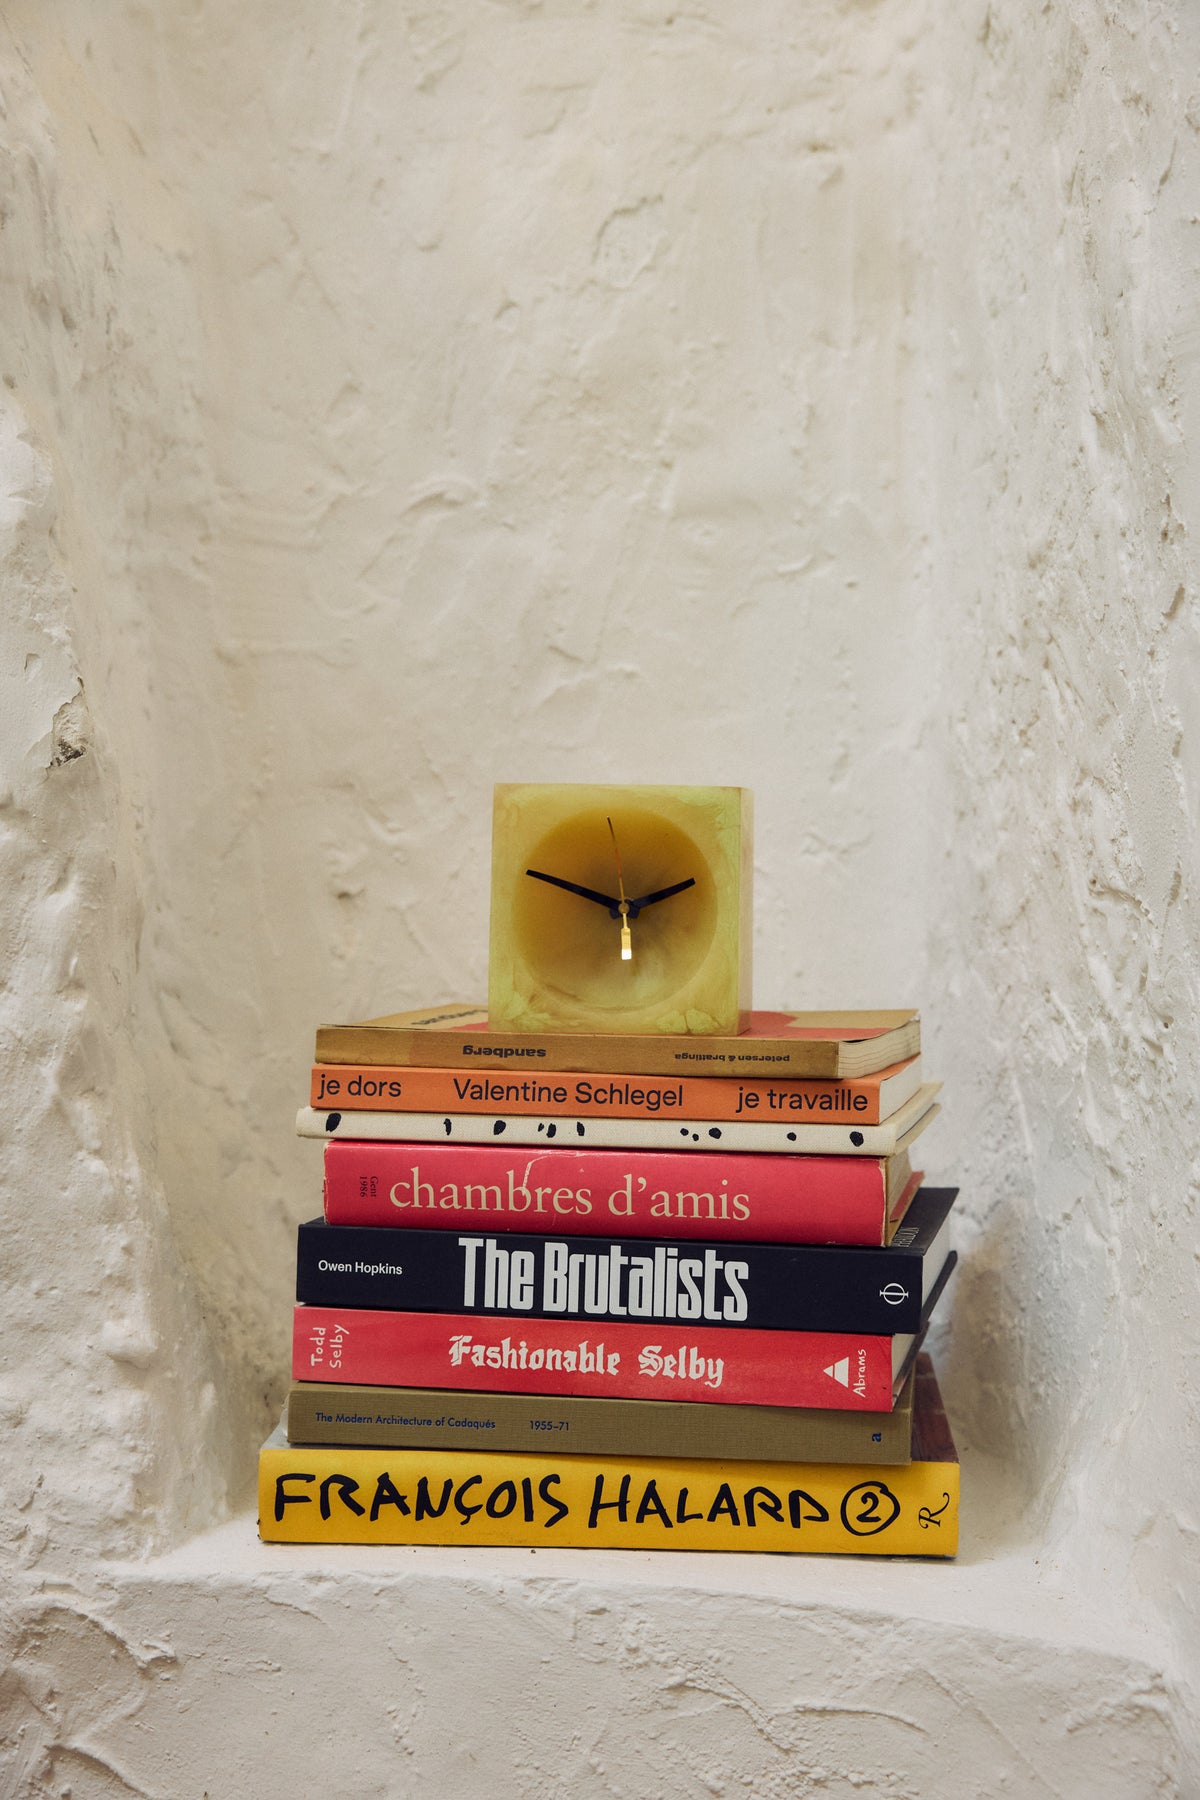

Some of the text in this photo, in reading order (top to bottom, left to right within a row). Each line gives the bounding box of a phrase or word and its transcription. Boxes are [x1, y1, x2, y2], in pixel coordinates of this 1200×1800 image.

[462, 1044, 547, 1059] sandberg
[674, 1052, 726, 1062] brattinga
[737, 1054, 791, 1063] petersen
[317, 1073, 402, 1100] je dors
[453, 1078, 683, 1112] Valentine Schlegel
[735, 1086, 869, 1114] je travaille
[359, 1176, 368, 1198] 1986
[370, 1175, 379, 1198] Gent
[389, 1166, 593, 1215] chambres
[318, 1259, 403, 1276] Owen Hopkins
[458, 1237, 749, 1322] The Brutalists
[310, 1327, 327, 1367] Todd
[329, 1324, 350, 1369] Selby
[448, 1334, 725, 1388] Fashionable Selby
[852, 1348, 867, 1398] Abrams
[315, 1412, 496, 1430] The Modern Architecture of Cadaqués
[274, 1471, 569, 1528] FRANÇOIS
[587, 1473, 830, 1529] HALARD
